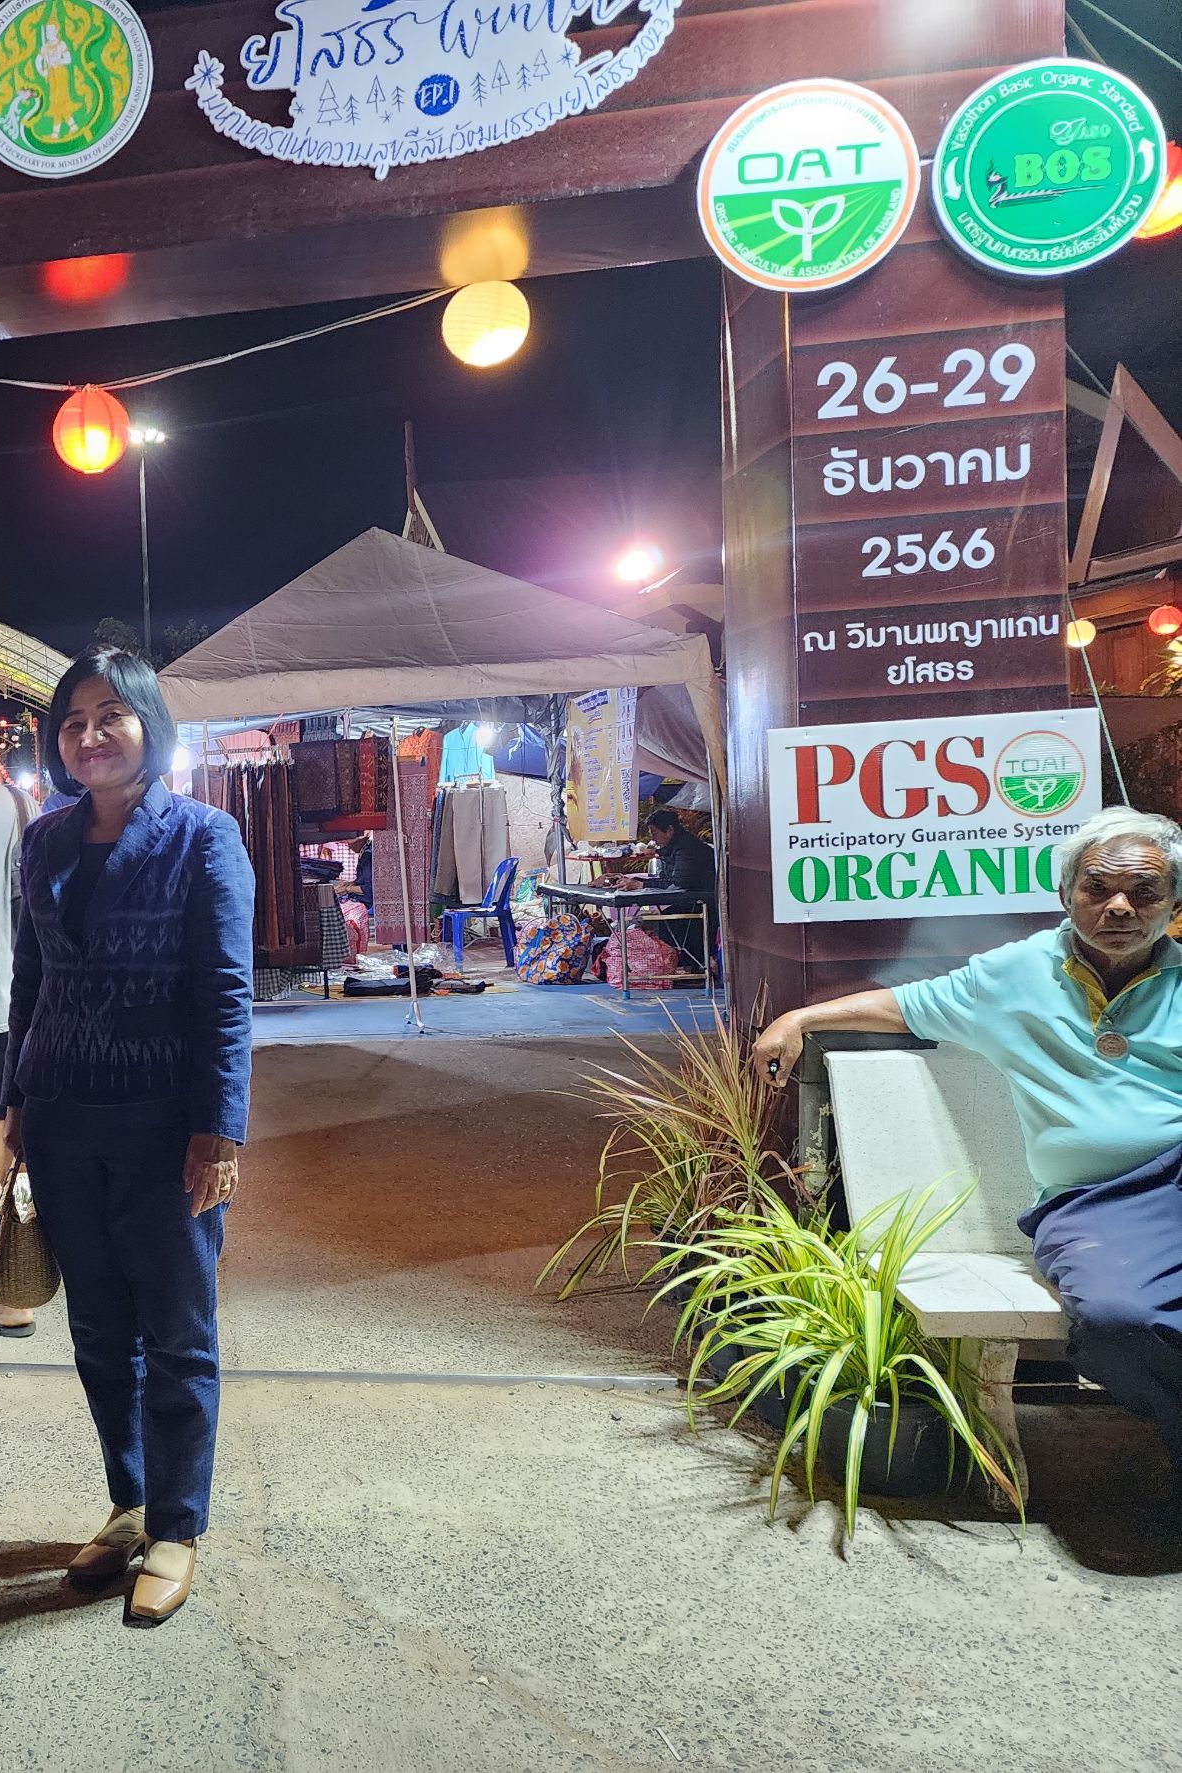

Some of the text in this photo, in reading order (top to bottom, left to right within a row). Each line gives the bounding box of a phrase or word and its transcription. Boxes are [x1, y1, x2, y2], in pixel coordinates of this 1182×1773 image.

[637, 18, 671, 63] 2023
[950, 71, 1145, 151] Yasothon Basic Organic Standard
[738, 142, 881, 184] OAT
[1014, 146, 1112, 187] BOS
[734, 242, 795, 277] AGRICULTURE
[798, 247, 864, 276] ASSOCIATION
[874, 187, 902, 239] THAILAND
[816, 342, 1036, 420] 26-29
[822, 442, 1031, 496] ธันวาคม
[860, 527, 996, 577] 2566
[802, 614, 1060, 652] ณ วิมานพญาแถน
[886, 656, 974, 685] ยโสธร
[785, 735, 991, 826] PGS
[788, 830, 906, 850] Participatory
[912, 825, 1008, 844] Guarantee
